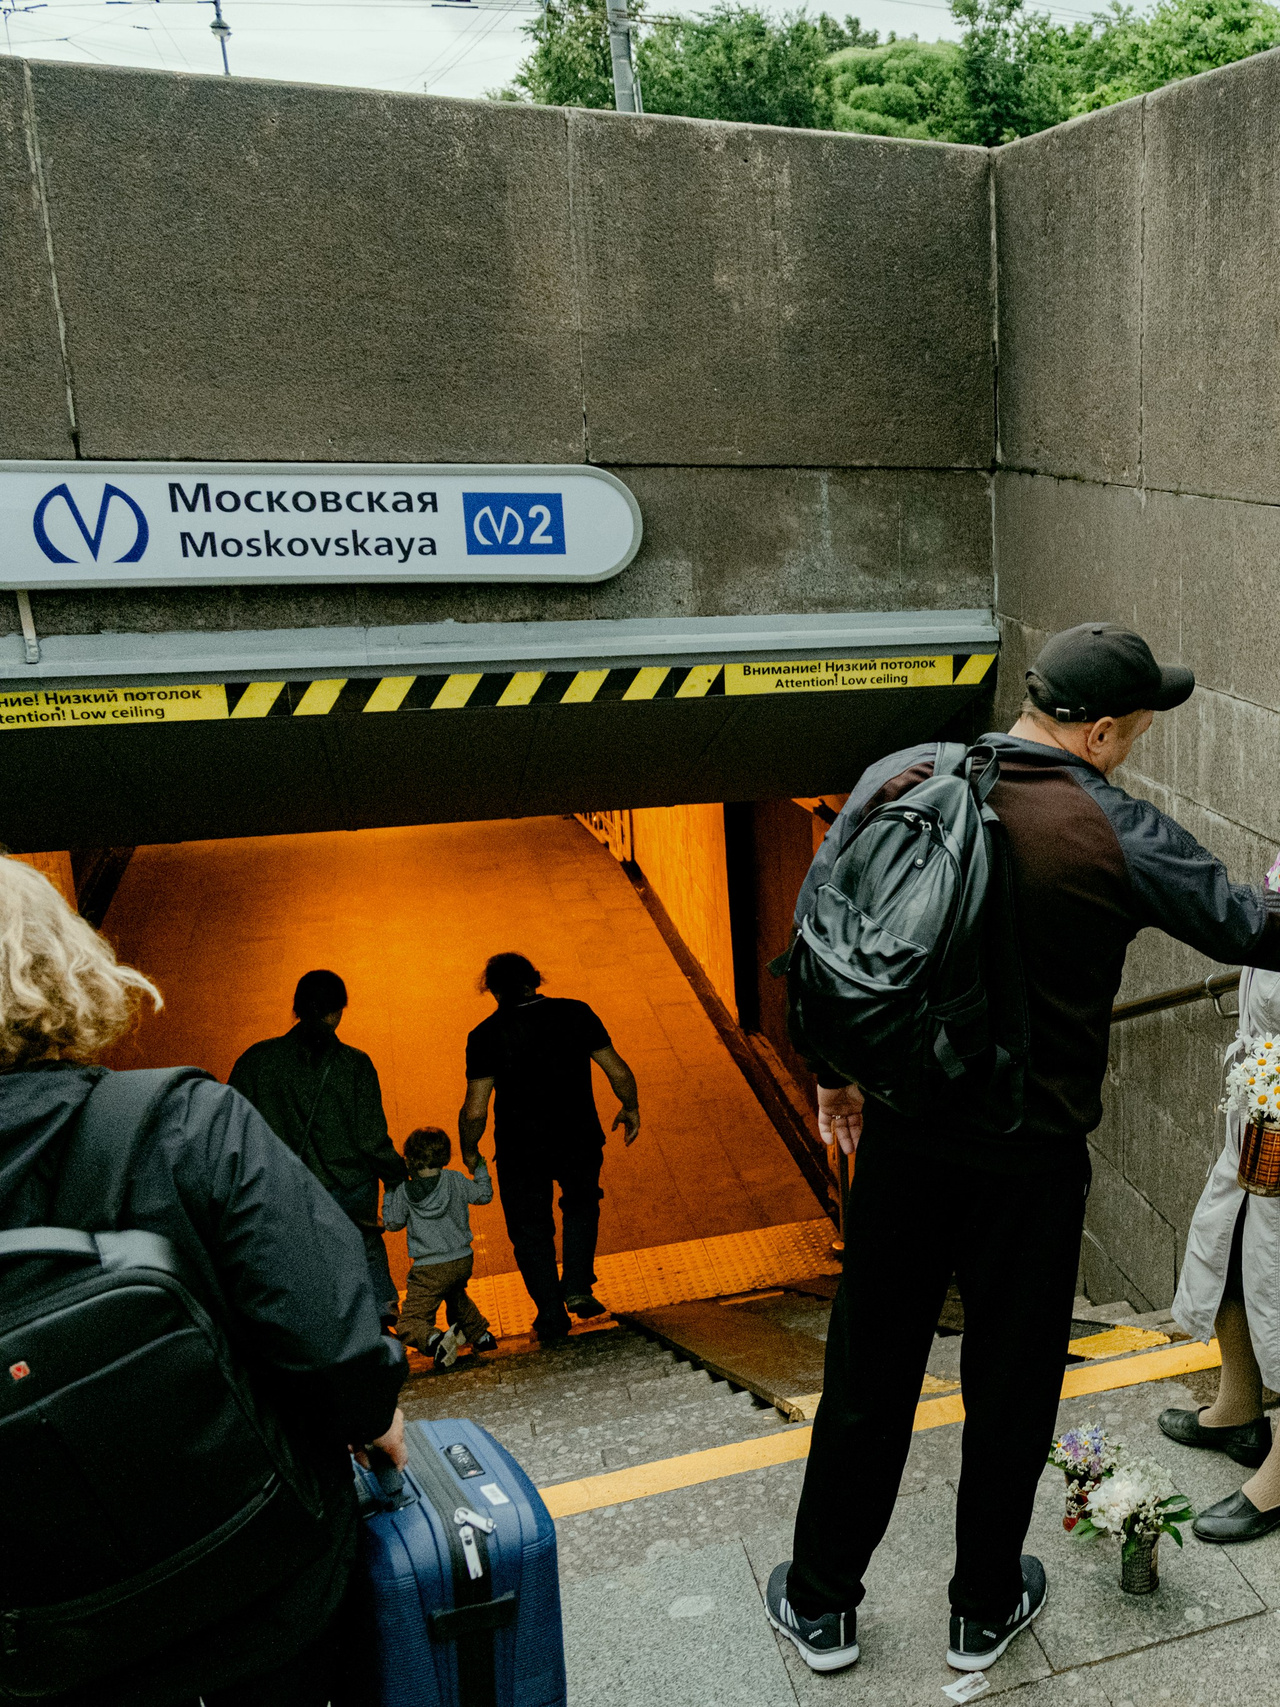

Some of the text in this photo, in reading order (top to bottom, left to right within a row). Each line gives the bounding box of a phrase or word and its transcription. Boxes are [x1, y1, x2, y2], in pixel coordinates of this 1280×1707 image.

[168, 482, 439, 513] Московская
[528, 504, 554, 544] 2
[179, 529, 438, 563] Moskovskaya
[742, 659, 936, 676] Внимание! Низкий потолок
[774, 673, 908, 688] Attention! Low ceiling
[44, 689, 119, 706] Низкий
[123, 689, 202, 702] потолок
[71, 709, 107, 720] Low
[111, 706, 165, 719] ceiling
